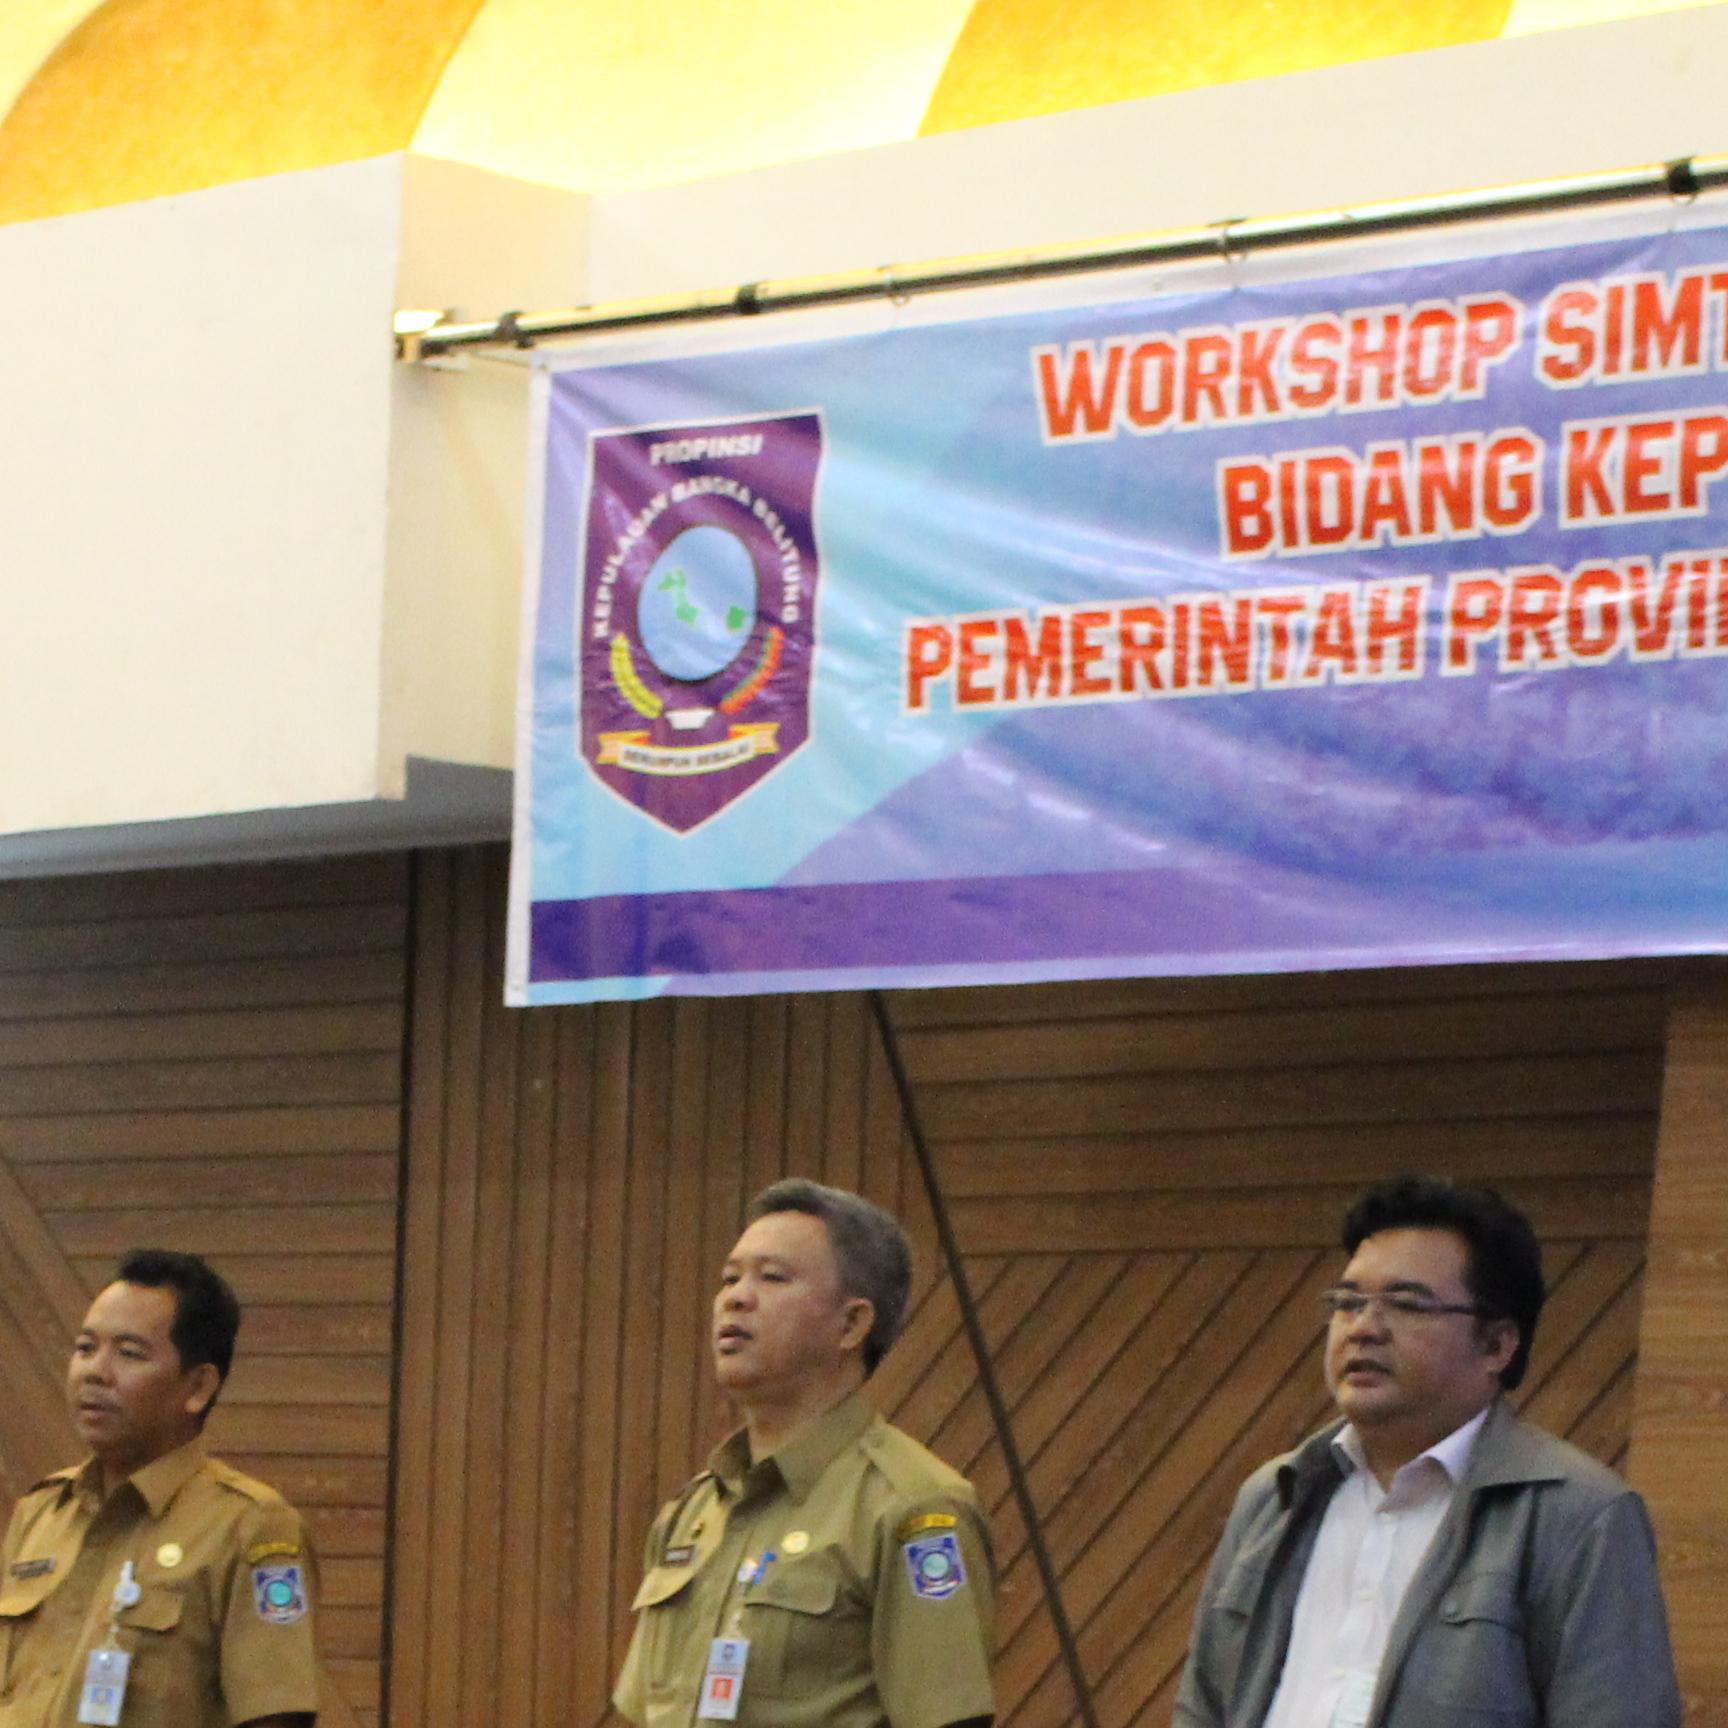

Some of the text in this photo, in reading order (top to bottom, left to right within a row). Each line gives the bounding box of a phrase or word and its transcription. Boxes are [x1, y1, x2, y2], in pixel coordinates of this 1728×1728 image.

[1038, 300, 1516, 440] WORKSHOP
[650, 434, 764, 466] PROPINSI
[1222, 436, 1536, 554] BIDANG
[592, 492, 670, 638] KEPULAUAN
[752, 497, 801, 624] BELITUNG
[906, 585, 1422, 708] PEMERINTAH
